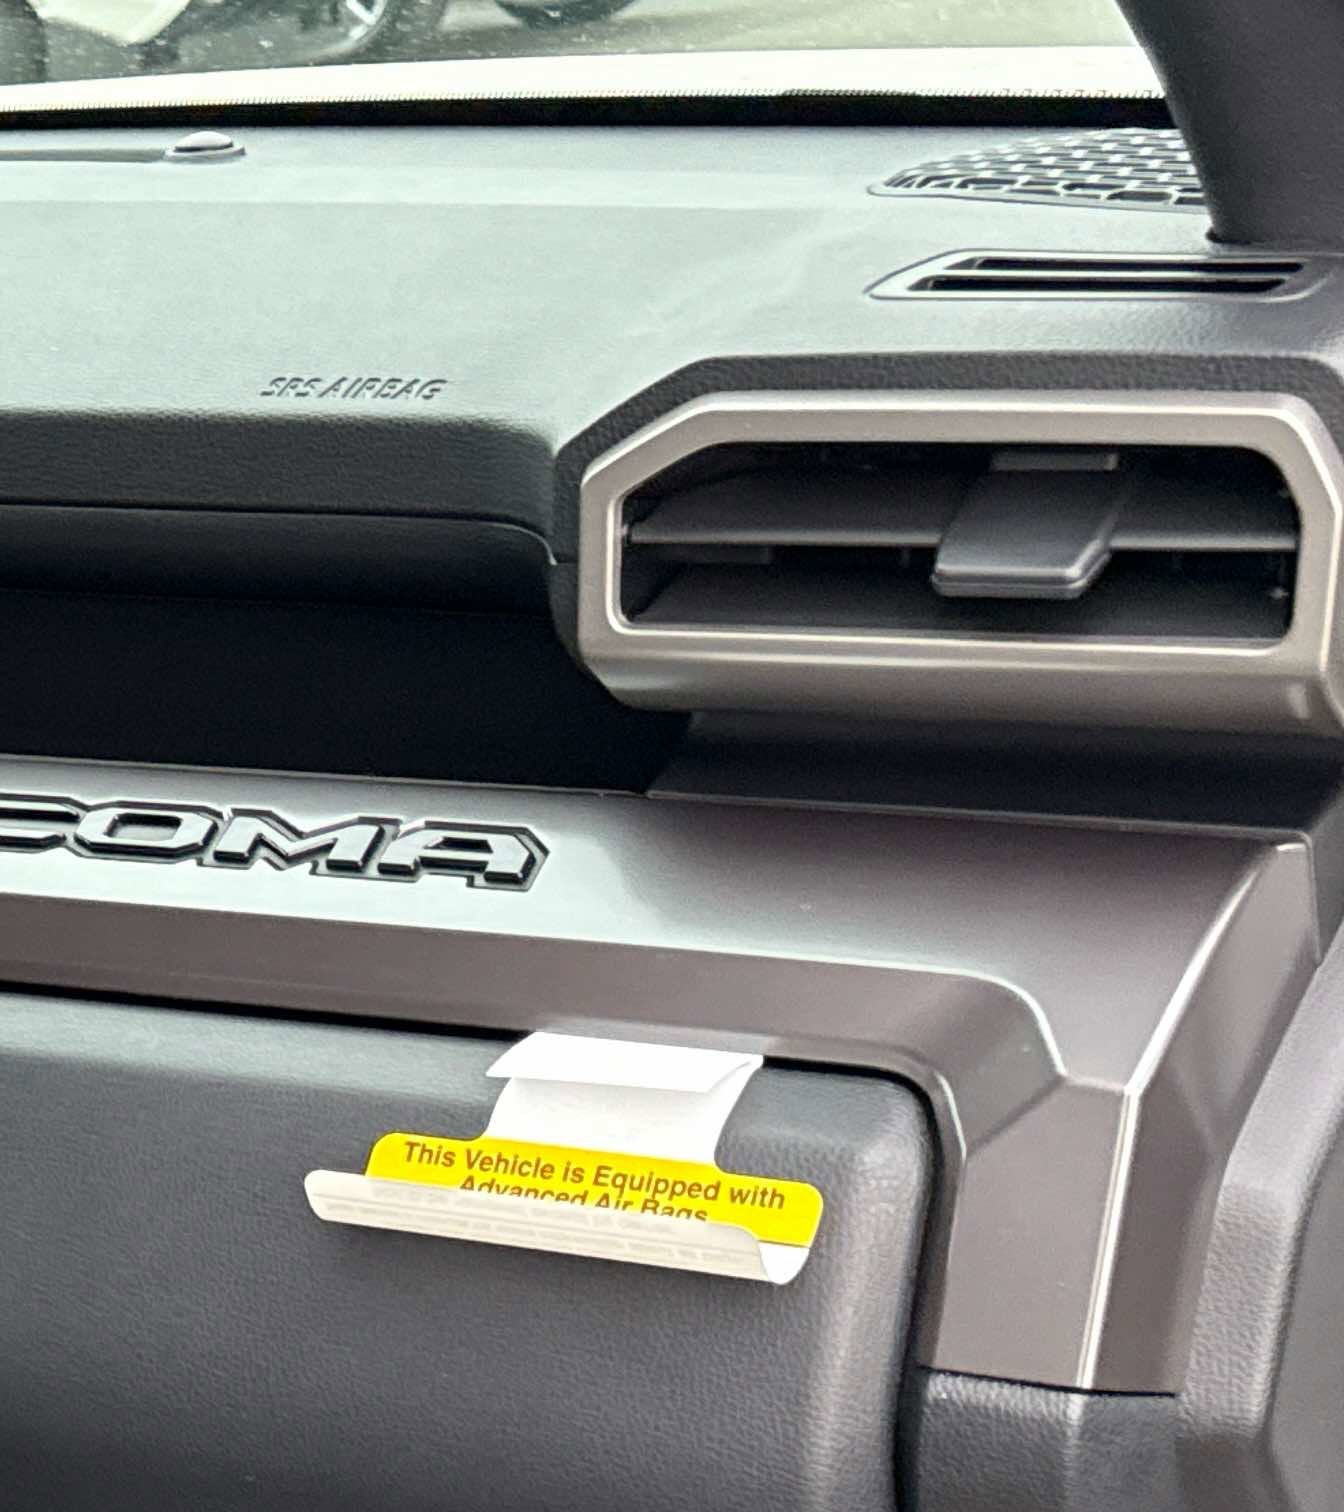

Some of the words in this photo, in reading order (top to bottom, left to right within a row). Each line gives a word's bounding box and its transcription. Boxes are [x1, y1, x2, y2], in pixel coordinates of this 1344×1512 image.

[403, 1140, 456, 1168] This
[464, 1149, 555, 1182] Vehicle
[562, 1160, 586, 1184] is
[592, 1164, 722, 1203] Equipped
[728, 1185, 786, 1210] with
